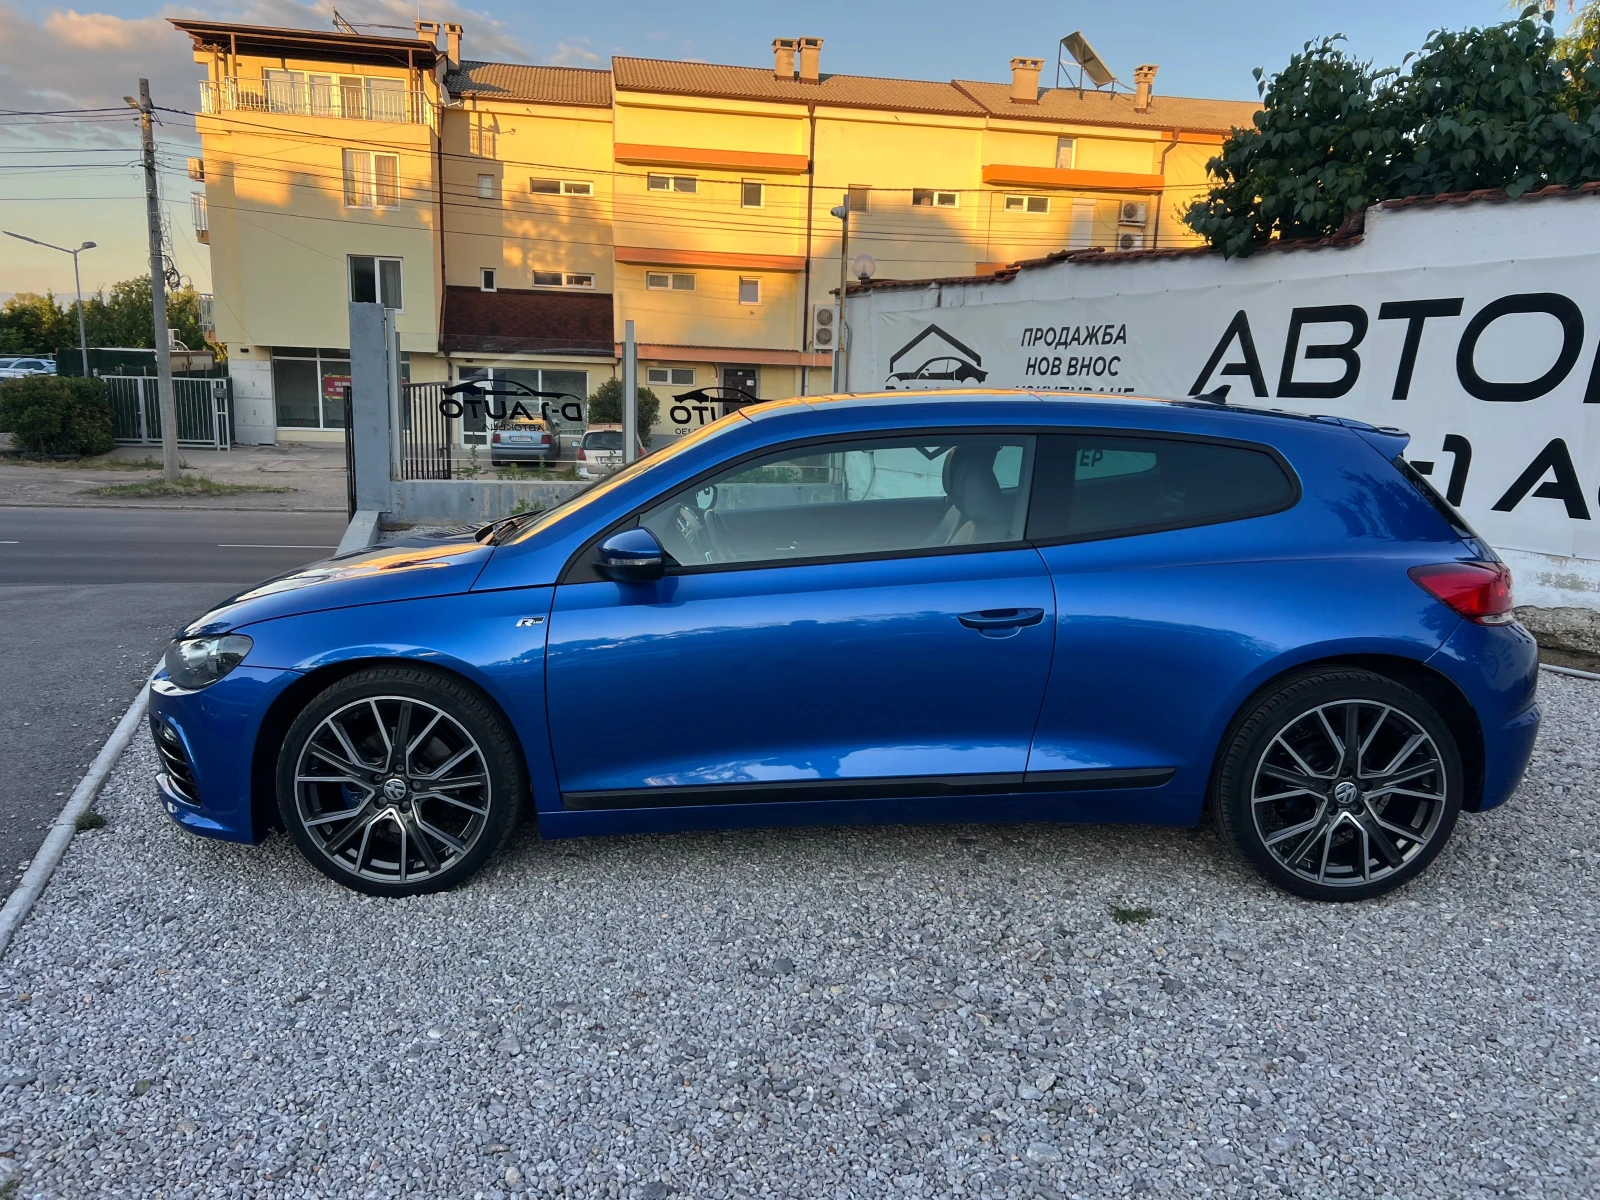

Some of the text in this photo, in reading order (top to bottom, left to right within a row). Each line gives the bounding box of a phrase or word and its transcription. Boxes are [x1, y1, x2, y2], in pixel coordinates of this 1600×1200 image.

[1021, 323, 1127, 350] ПРОДАЖБА
[1025, 355, 1121, 376] НОВ ВНОС
[1490, 437, 1600, 521] A
